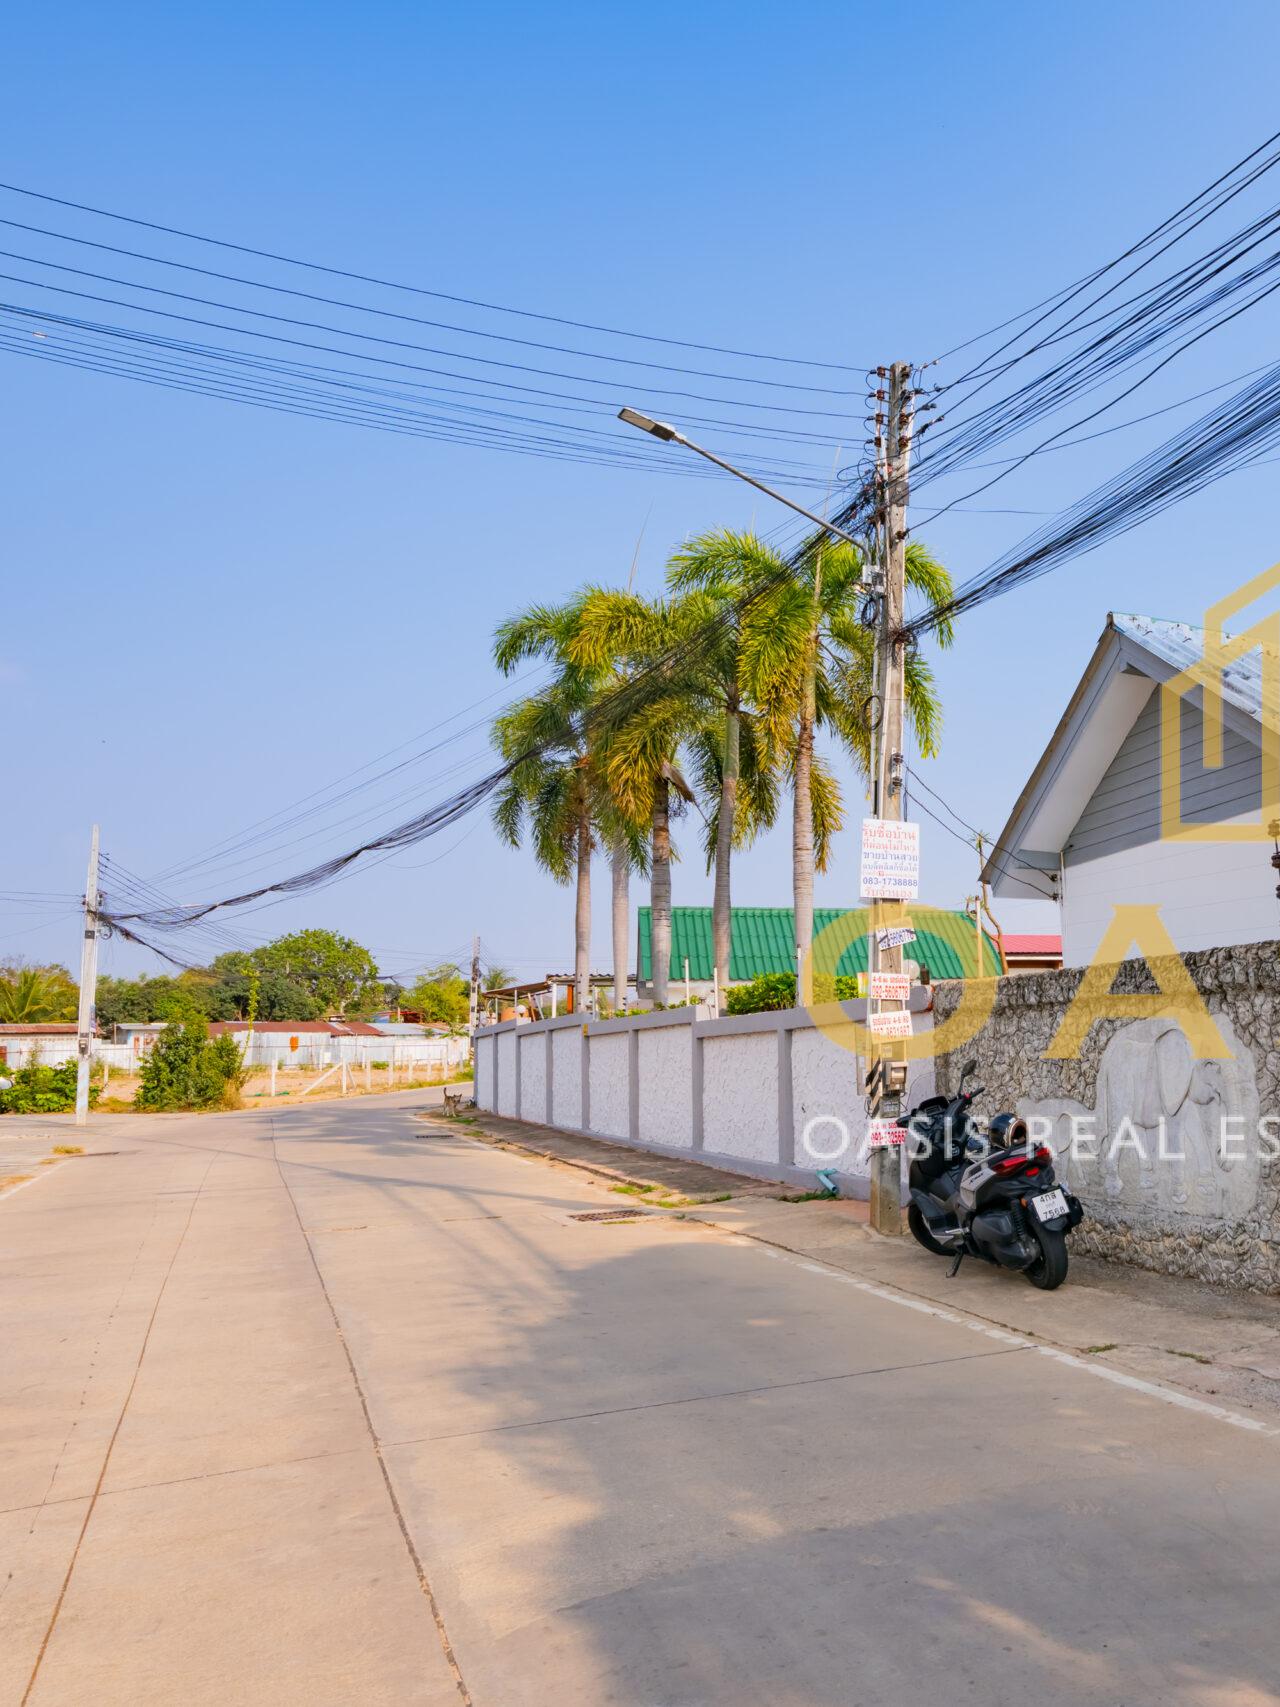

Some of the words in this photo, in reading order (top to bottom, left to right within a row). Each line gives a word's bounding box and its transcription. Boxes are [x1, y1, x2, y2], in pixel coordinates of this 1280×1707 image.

[863, 822, 917, 840] รับซื้อบ้าน
[863, 877, 918, 887] 083-1738888
[1042, 1206, 1066, 1219] 7568
